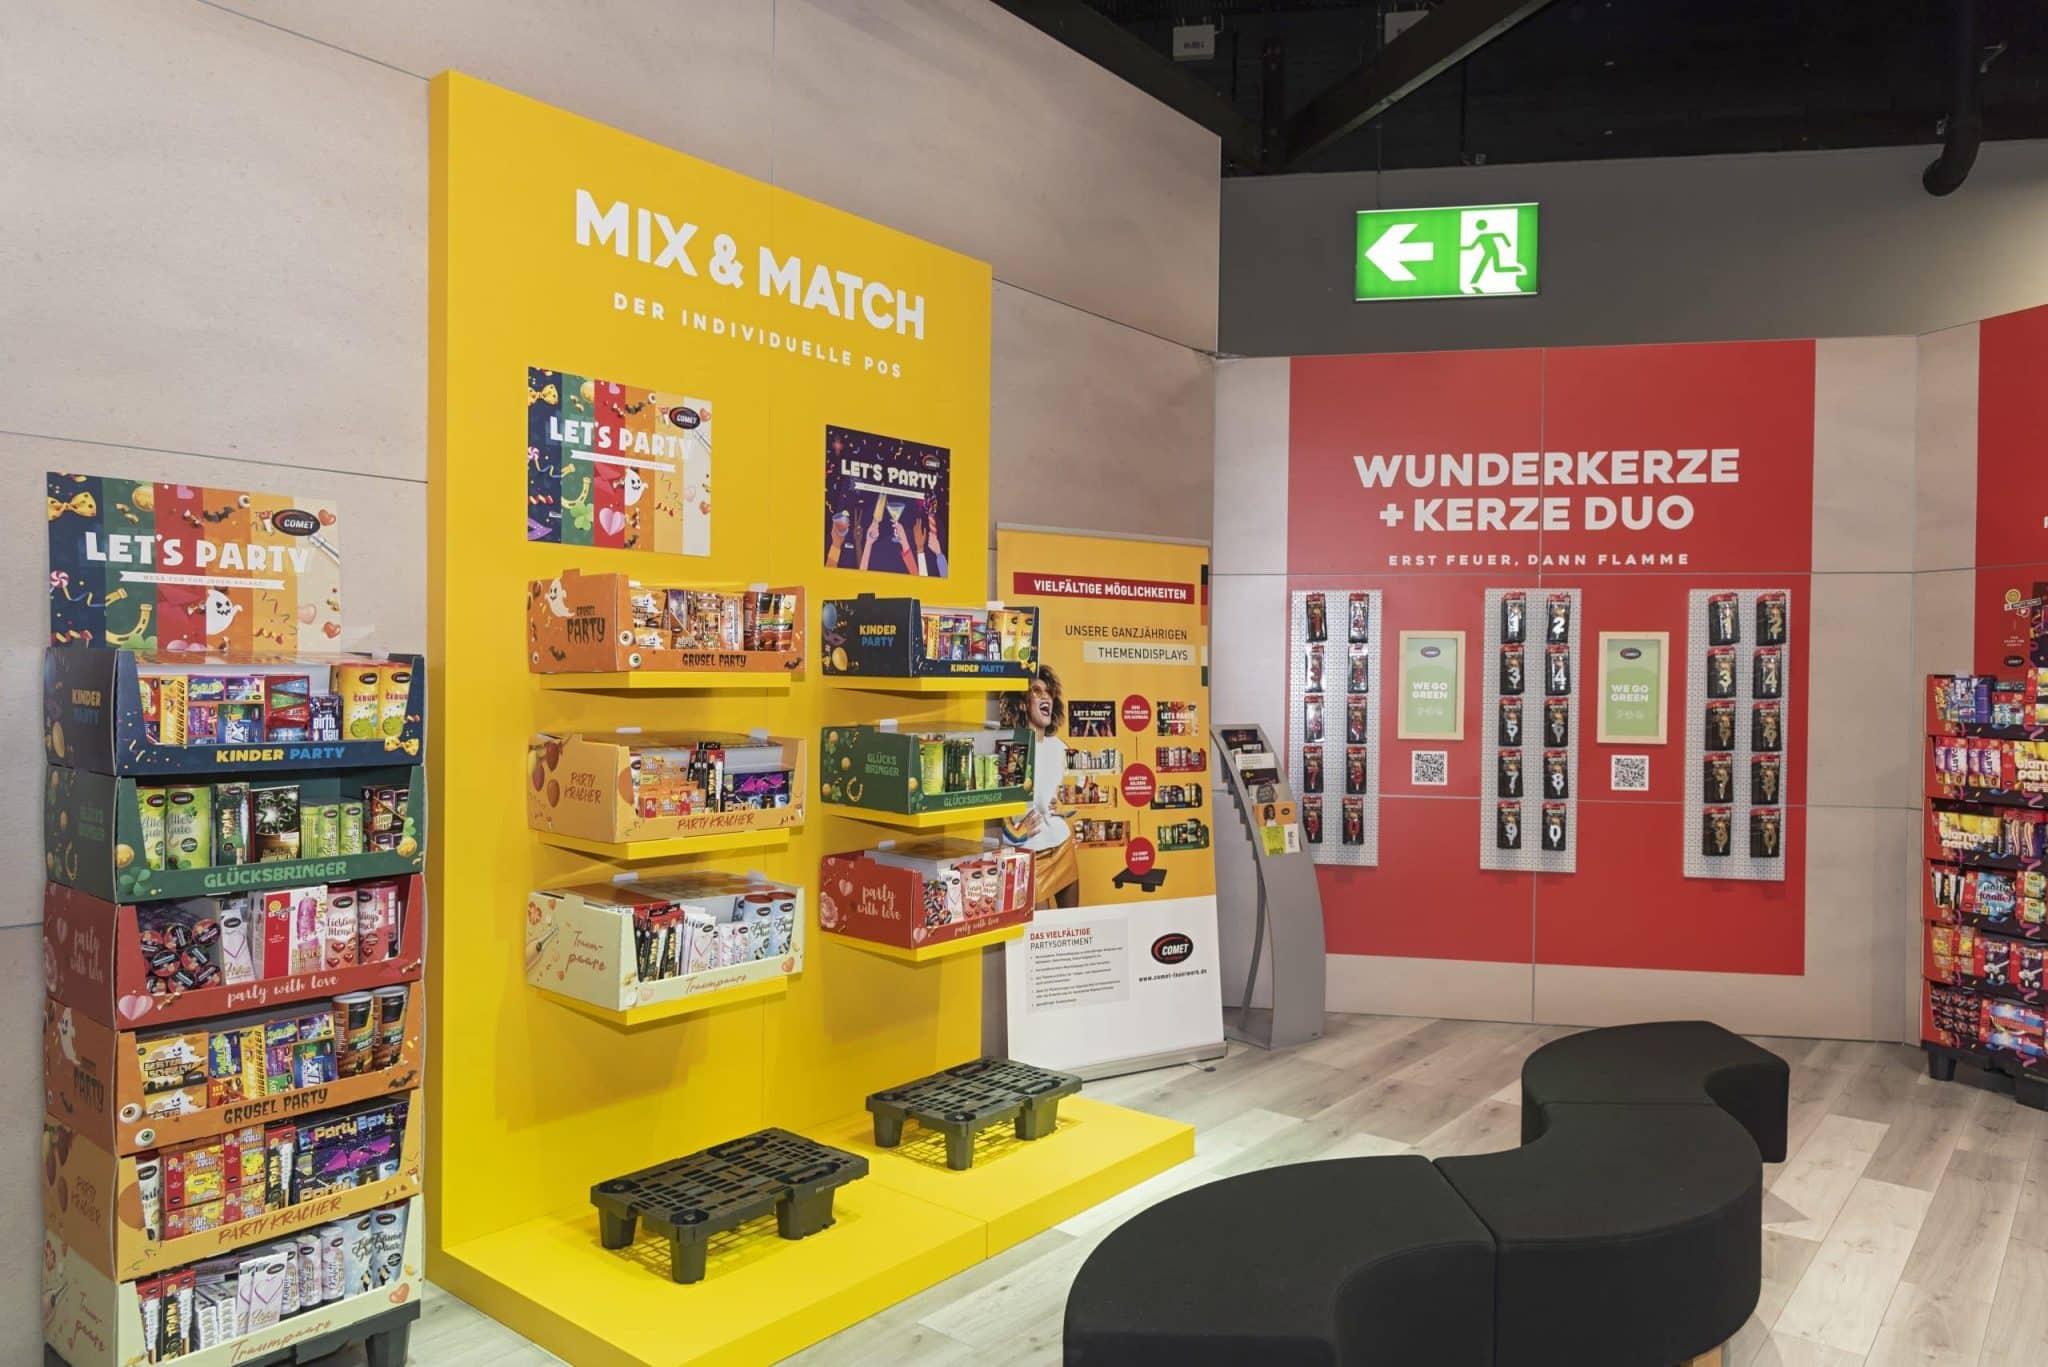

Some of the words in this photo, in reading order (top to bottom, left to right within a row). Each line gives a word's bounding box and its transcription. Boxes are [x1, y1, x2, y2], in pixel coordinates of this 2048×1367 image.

[575, 188, 698, 277] MIX
[709, 233, 744, 289] &
[759, 246, 925, 340] MATCH
[614, 292, 665, 320] DER
[682, 309, 852, 366] INDIVIDUELLE
[864, 355, 902, 378] POS
[550, 415, 612, 449] LET'S
[619, 427, 693, 460] PARTY
[841, 458, 883, 482] LET'S
[887, 466, 938, 490] PARTY
[1353, 448, 1740, 488] WUNDERKERZE
[1379, 503, 1404, 528] +
[1414, 496, 1570, 532] KERZE
[1584, 495, 1695, 531] DUO
[283, 517, 315, 530] COMET
[85, 531, 184, 568] LET'S
[195, 539, 313, 574] PARTY
[1388, 555, 1437, 566] ERST
[1447, 554, 1519, 568] FEUER,
[1527, 554, 1587, 566] DANN
[1598, 553, 1690, 566] FLAMME
[1034, 579, 1102, 595] VIELFÄLTIGE
[1104, 582, 1186, 600] MÖGLICHKEITEN
[566, 616, 605, 646] PARTY
[859, 624, 897, 636] KINDER
[1065, 624, 1108, 637] UNSERE
[1111, 625, 1188, 640] GANZJÄHRIGEN
[1552, 616, 1566, 634] 2
[861, 636, 894, 648] PARTY
[682, 653, 715, 668] GRUSEL
[718, 653, 747, 668] PARTY
[1098, 647, 1189, 661] THEMENDISPLAYS
[950, 663, 979, 673] KINDER
[980, 663, 1005, 673] PARTY
[1412, 681, 1430, 691] WE
[1431, 681, 1448, 691] GO
[1719, 669, 1732, 686] 3
[1765, 671, 1778, 688] 4
[1411, 690, 1448, 700] GREEN
[1610, 683, 1629, 693] WE
[1631, 684, 1649, 693] GO
[72, 688, 102, 706] KINDER
[1610, 693, 1649, 703] GREEN
[1506, 720, 1518, 737] 5
[216, 749, 285, 764] KINDER
[289, 746, 346, 761] PARTY
[866, 751, 897, 764] GLÜCKS
[570, 771, 596, 786] PARTY
[864, 764, 900, 777] BRINGER
[1551, 773, 1564, 789] 8
[563, 785, 601, 805] KRACHER
[677, 816, 709, 832] PARTY
[709, 812, 755, 828] KRACHER
[1505, 823, 1517, 840] 9
[1550, 825, 1561, 842] 0
[203, 861, 347, 889] GLÜCKSBRINGER
[862, 883, 897, 910] party
[856, 903, 879, 916] with
[881, 904, 902, 921] love
[1030, 932, 1045, 941] DAS
[1046, 927, 1091, 939] VIELFÄLTIGE
[1030, 936, 1094, 951] PARTYSORTIMENT
[1160, 943, 1190, 956] COMET
[227, 985, 268, 1007] party
[273, 977, 305, 996] with
[311, 974, 338, 991] love
[223, 1099, 278, 1124] GRUSEL
[283, 1088, 329, 1113] PARTY
[218, 1215, 267, 1244] PARTY
[270, 1196, 343, 1231] KRACHER
[229, 1318, 333, 1363] Traumpaare
